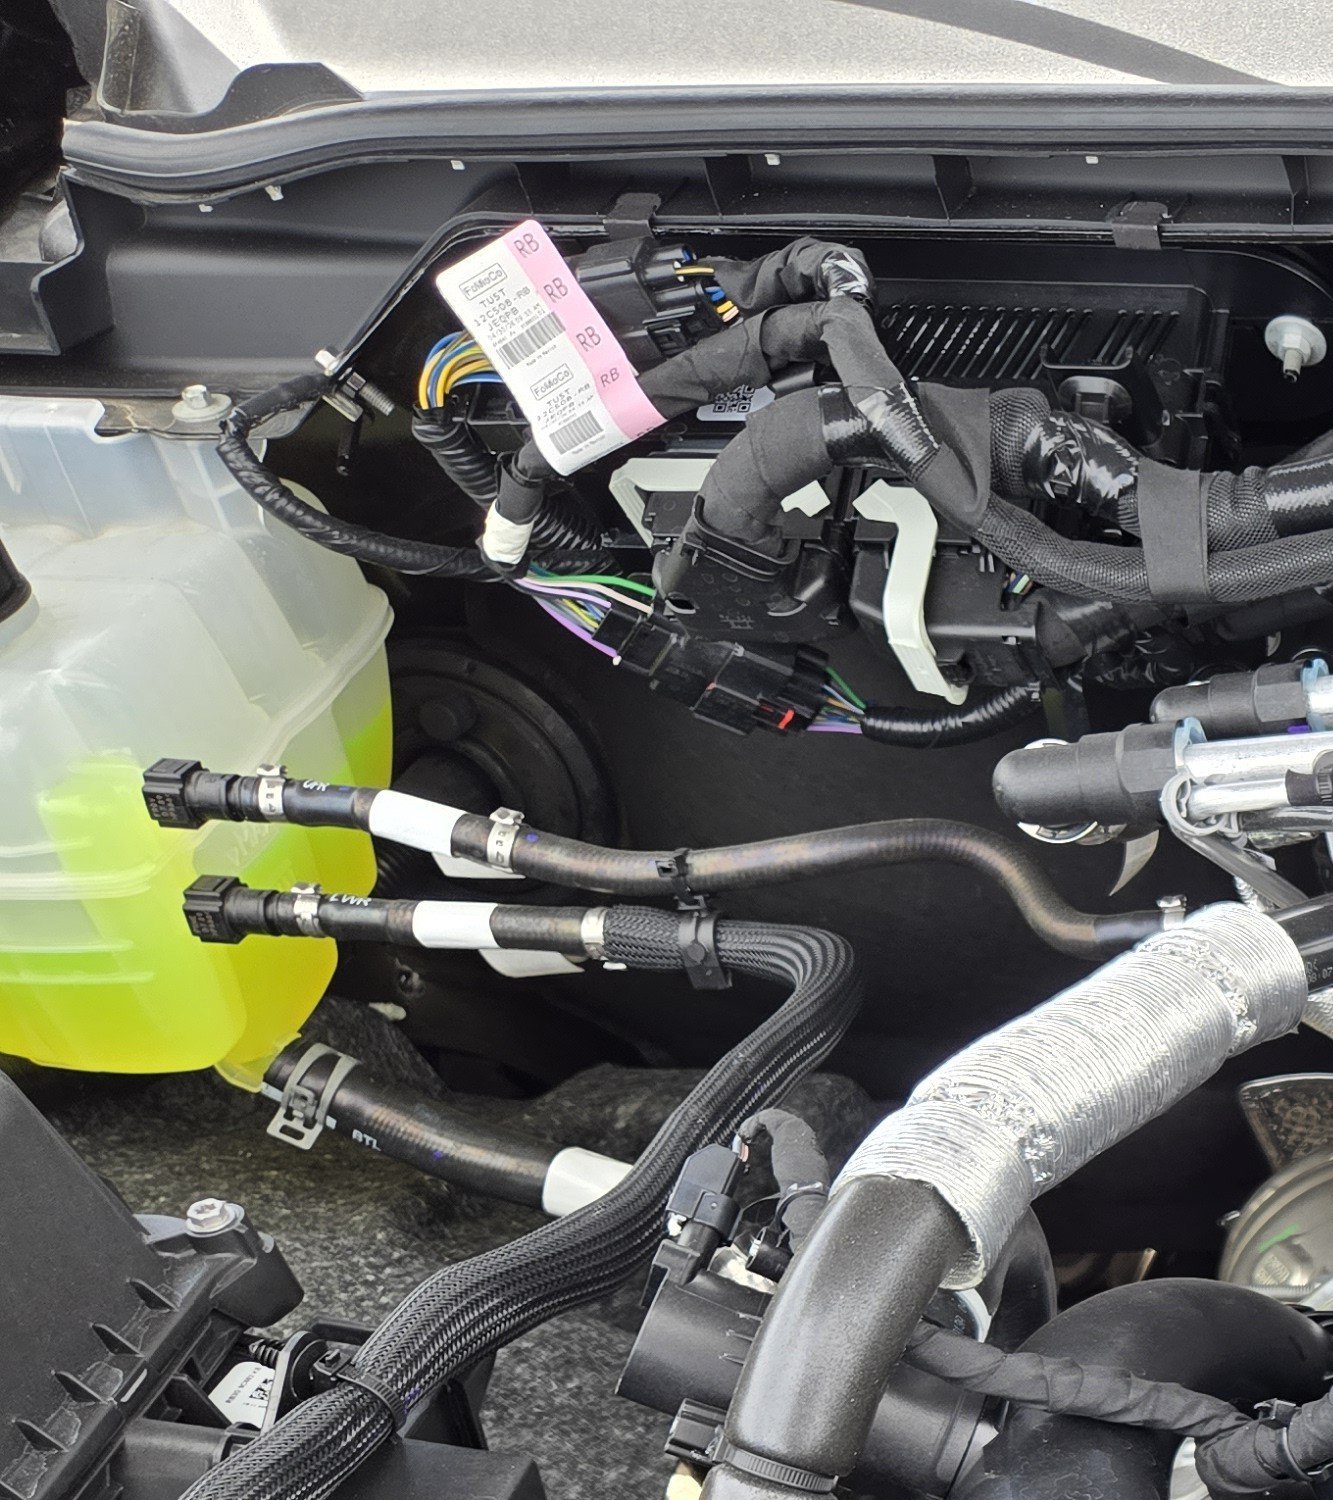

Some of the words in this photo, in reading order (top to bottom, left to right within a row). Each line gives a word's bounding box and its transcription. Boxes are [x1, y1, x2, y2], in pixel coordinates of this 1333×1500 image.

[514, 233, 539, 258] RB
[463, 269, 503, 297] FoMoCo
[543, 277, 569, 303] RB
[576, 326, 601, 352] RB
[533, 369, 570, 396] FoMoCo
[600, 368, 620, 388] RB
